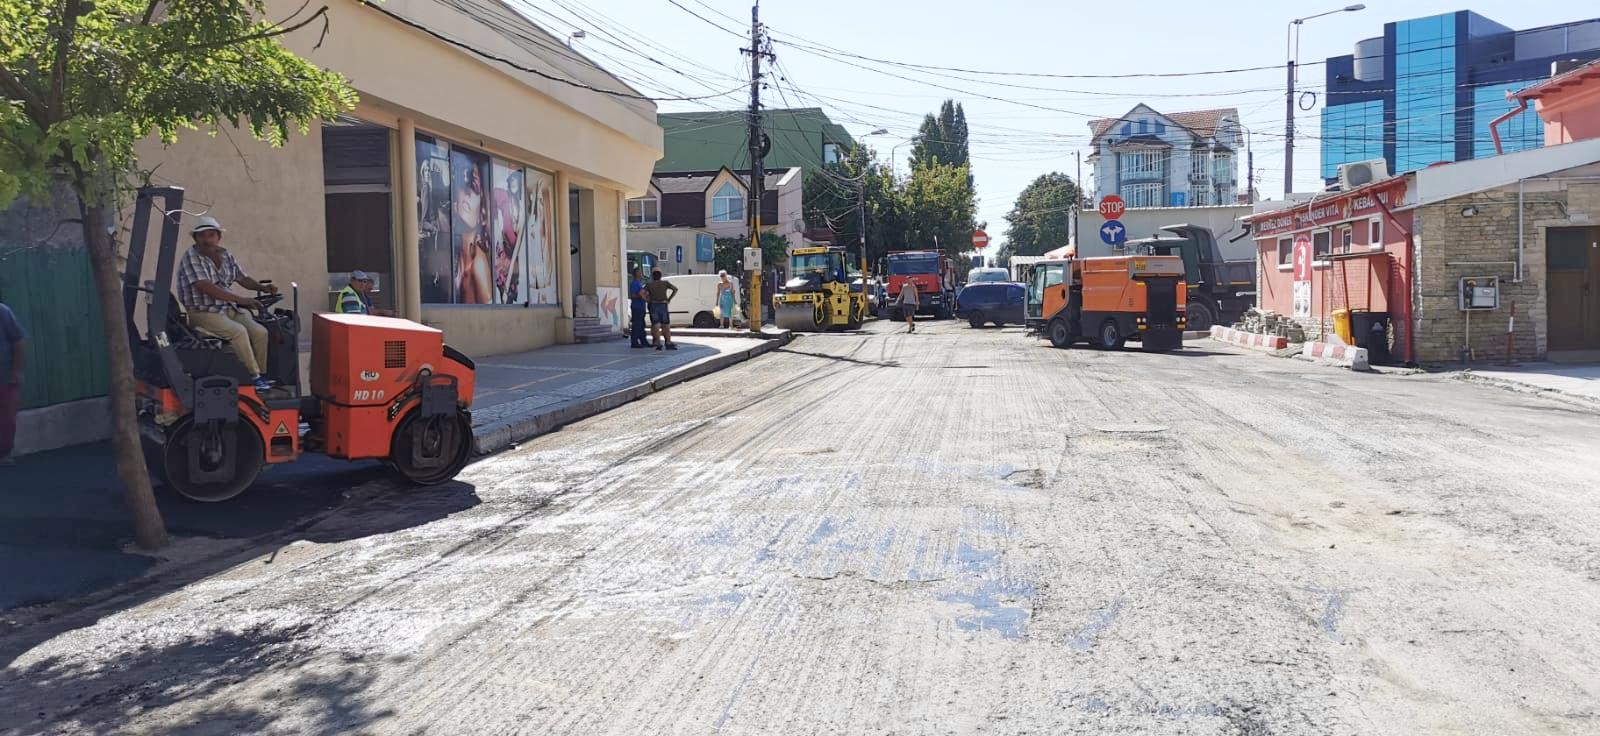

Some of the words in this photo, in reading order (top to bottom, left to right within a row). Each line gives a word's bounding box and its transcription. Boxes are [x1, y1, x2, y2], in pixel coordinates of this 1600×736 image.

[1101, 201, 1124, 214] STOP
[354, 390, 369, 400] HD
[371, 390, 384, 400] 10
